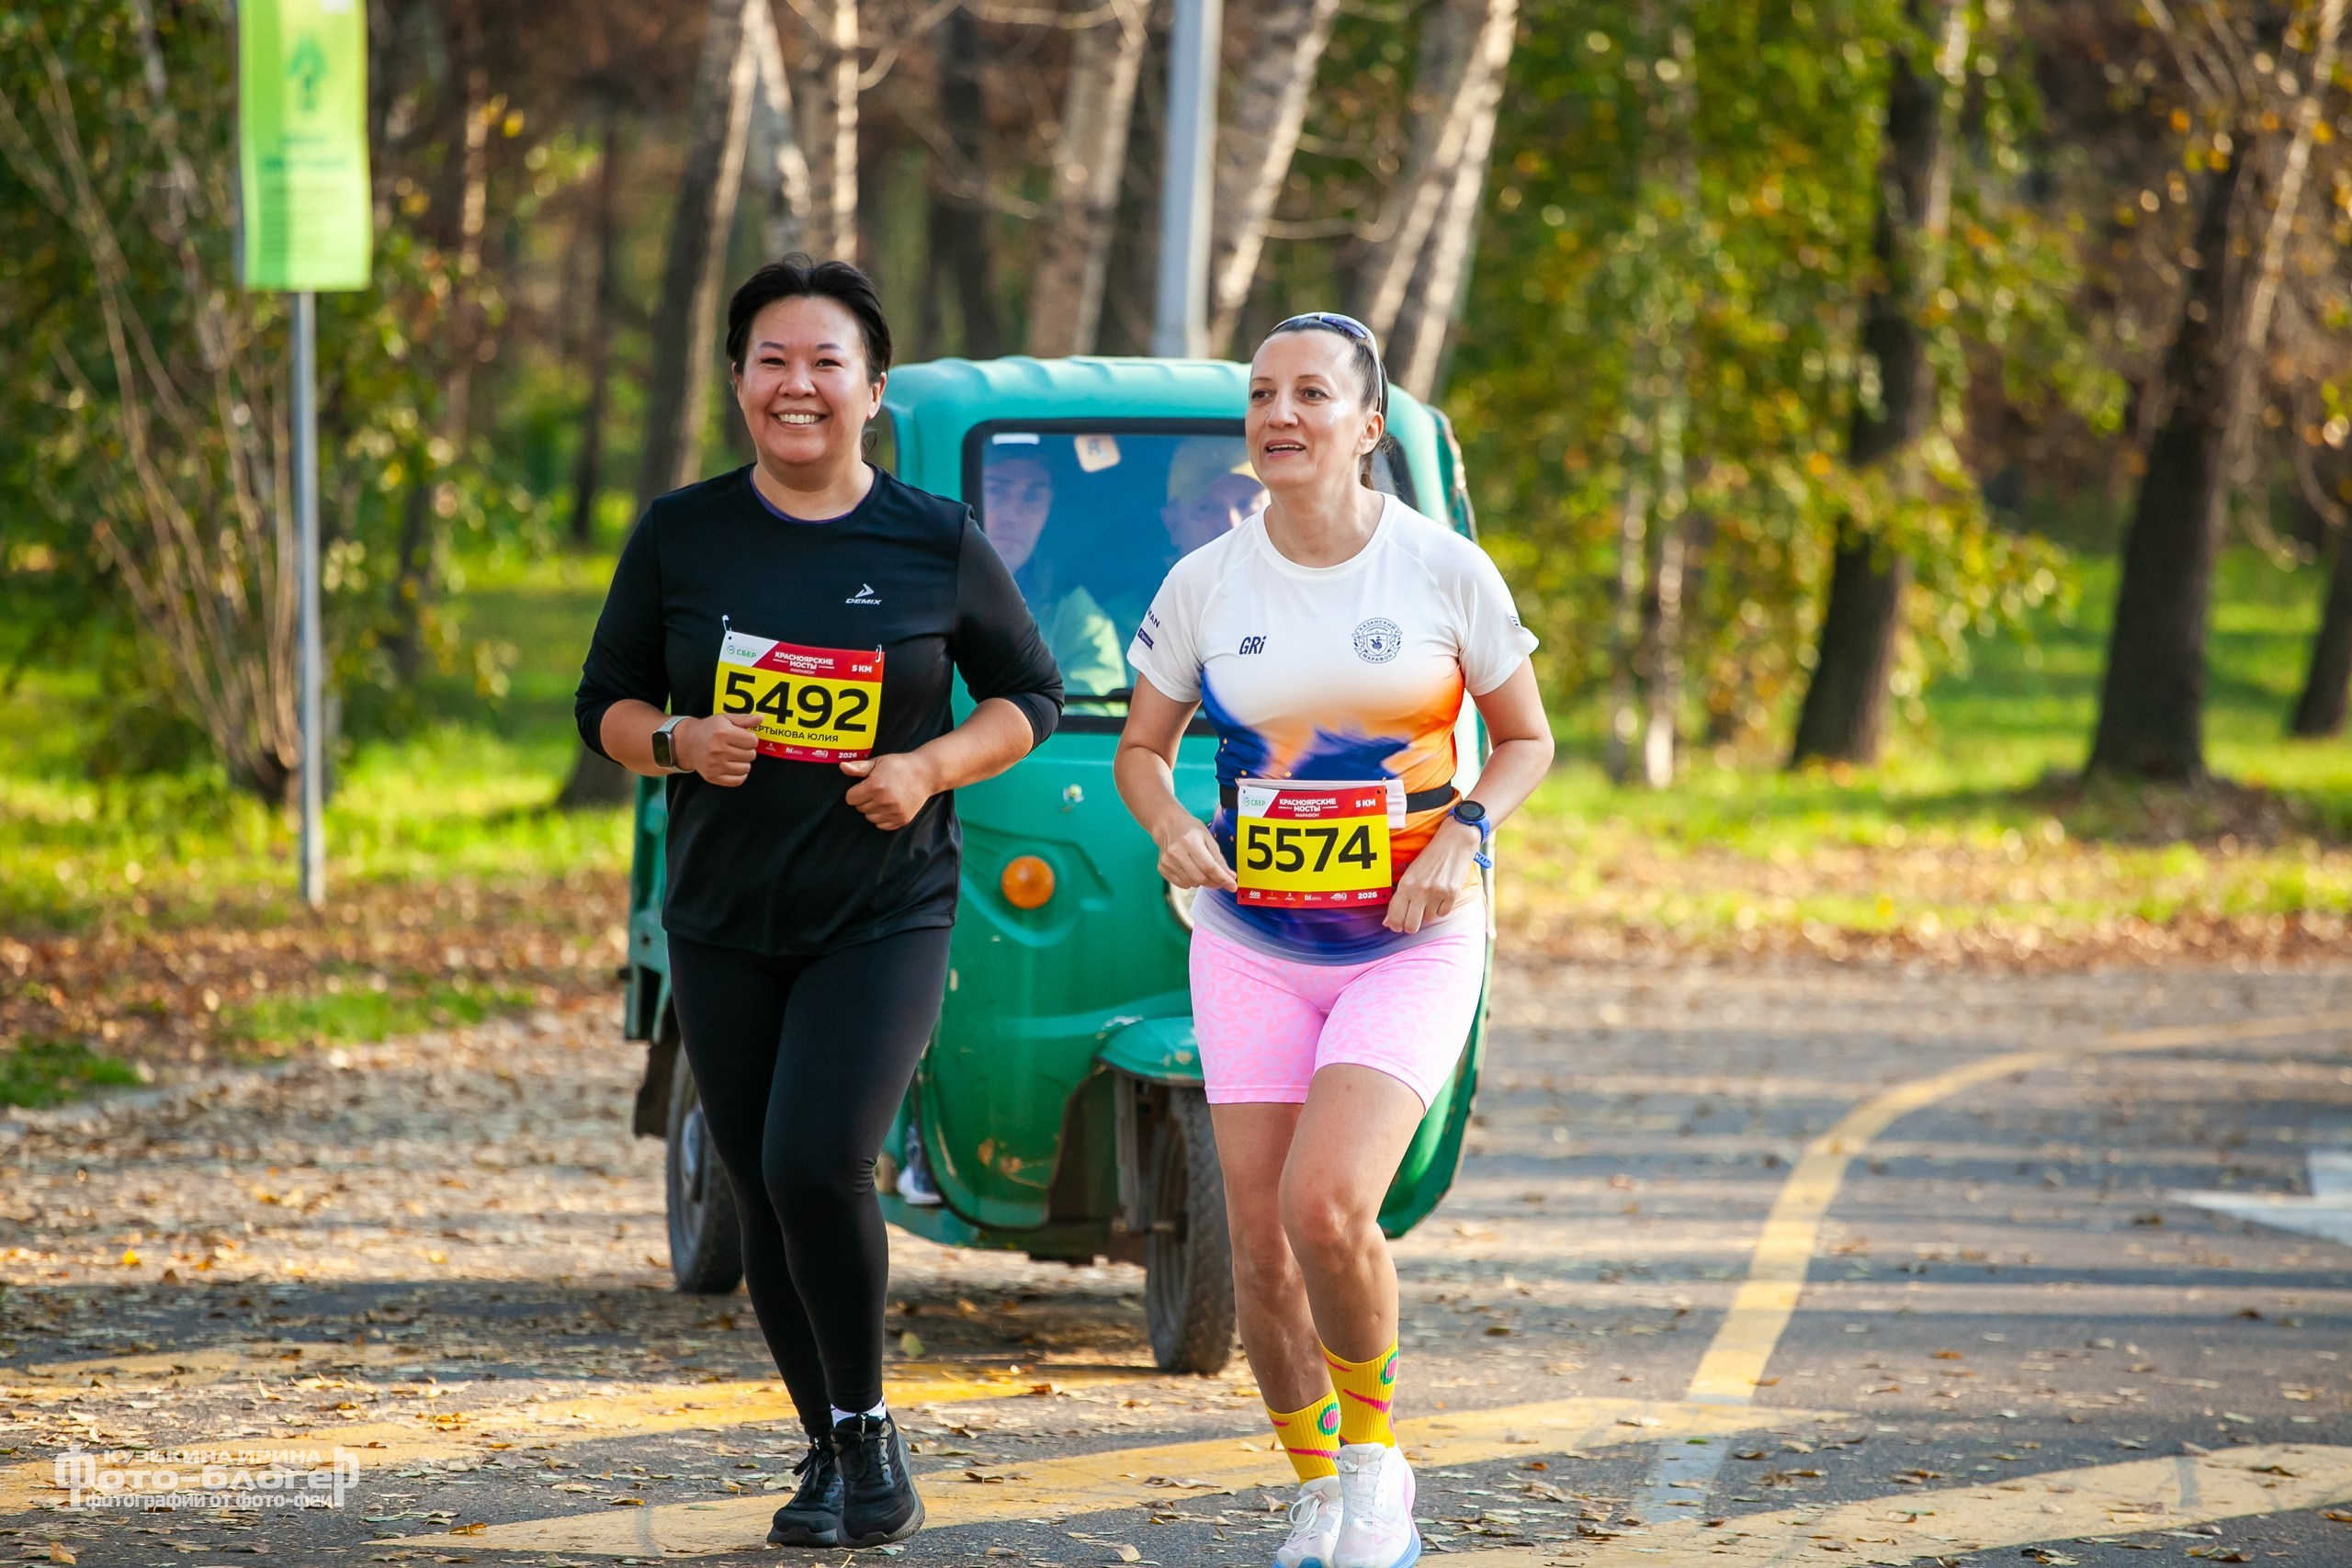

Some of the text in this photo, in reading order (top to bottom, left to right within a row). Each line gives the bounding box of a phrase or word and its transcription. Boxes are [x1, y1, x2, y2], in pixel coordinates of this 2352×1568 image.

[736, 649, 757, 659] СБЕР
[775, 651, 834, 666] КРАСНОЯРСКИЕ
[789, 660, 817, 671] МОСТЫ
[852, 664, 873, 673] 5 КМ
[722, 671, 870, 733] 5492
[750, 725, 839, 742] ЕРТЫКОВА ЮЛИЯ
[1279, 797, 1337, 806] КРАСНОЯРСКИЕ
[1355, 798, 1376, 808] 5 КМ
[1247, 824, 1377, 873] 5574
[1357, 891, 1378, 900] 2026
